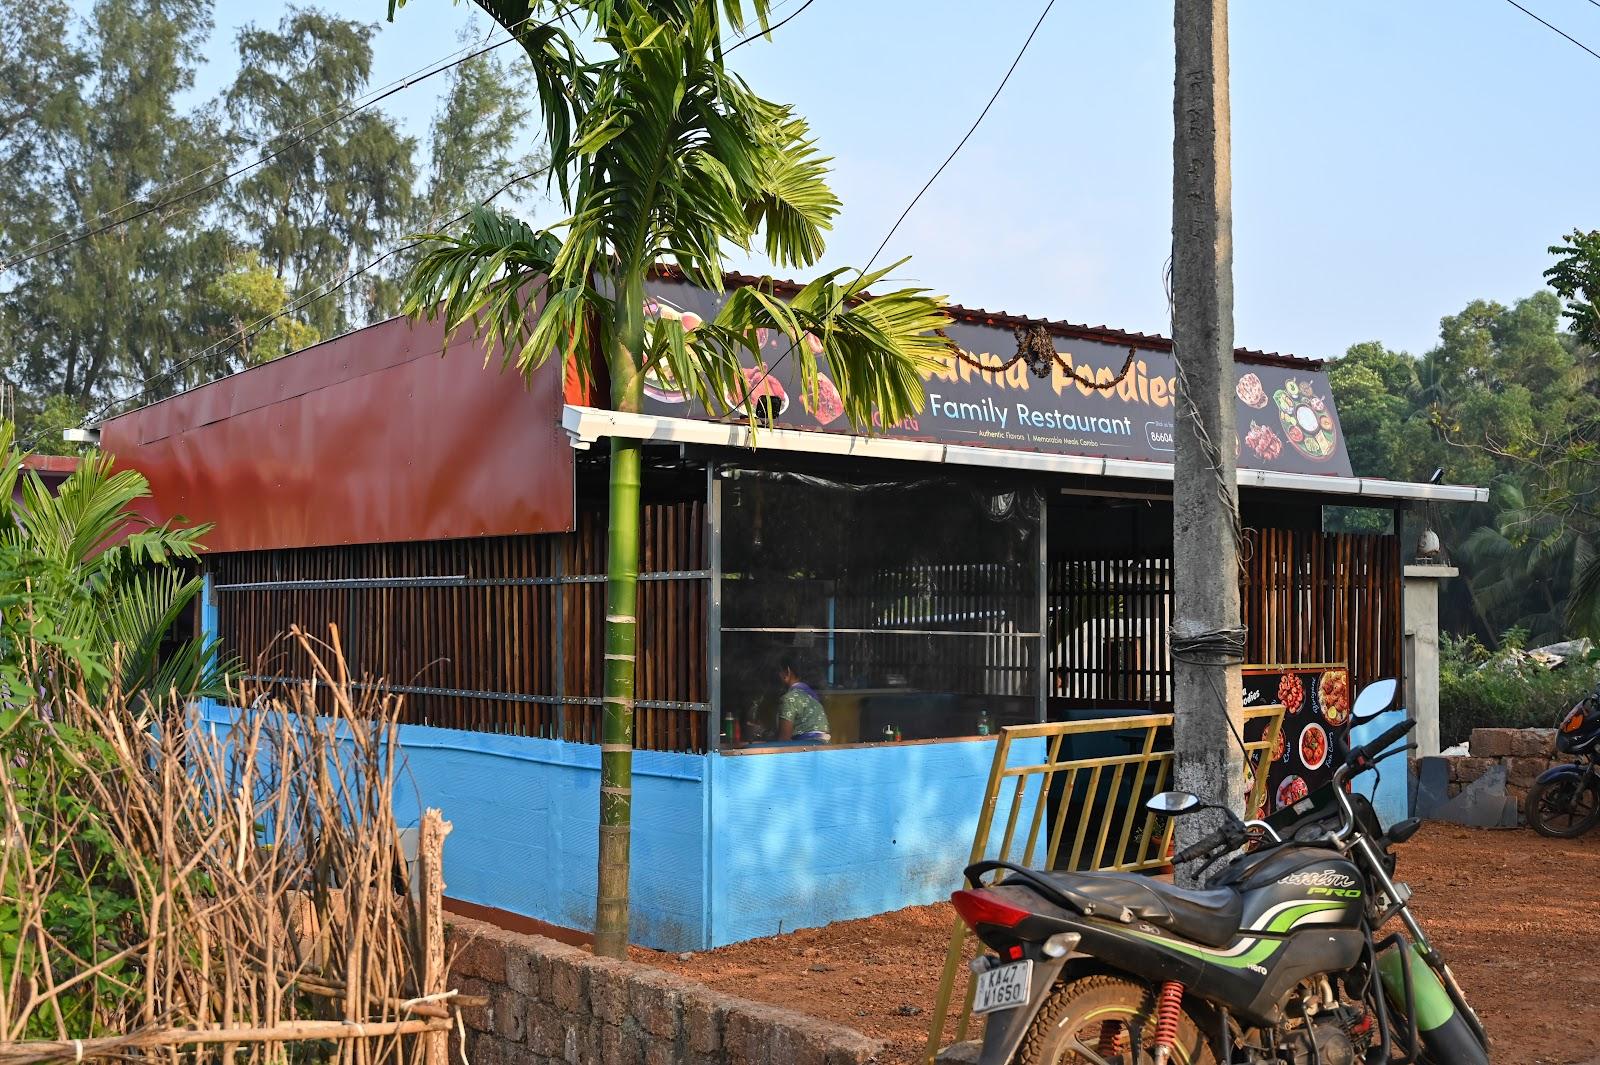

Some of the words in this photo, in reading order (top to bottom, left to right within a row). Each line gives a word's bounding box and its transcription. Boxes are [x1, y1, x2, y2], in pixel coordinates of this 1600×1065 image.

[919, 347, 1029, 391] arna
[930, 393, 1008, 428] Family
[1016, 403, 1132, 436] Restaurant
[978, 429, 1005, 439] Authentic
[1032, 434, 1063, 444] Memorable
[1079, 438, 1099, 447] Combo
[1150, 431, 1174, 443] 86604
[1277, 869, 1356, 888] assion
[1307, 887, 1361, 898] PRO
